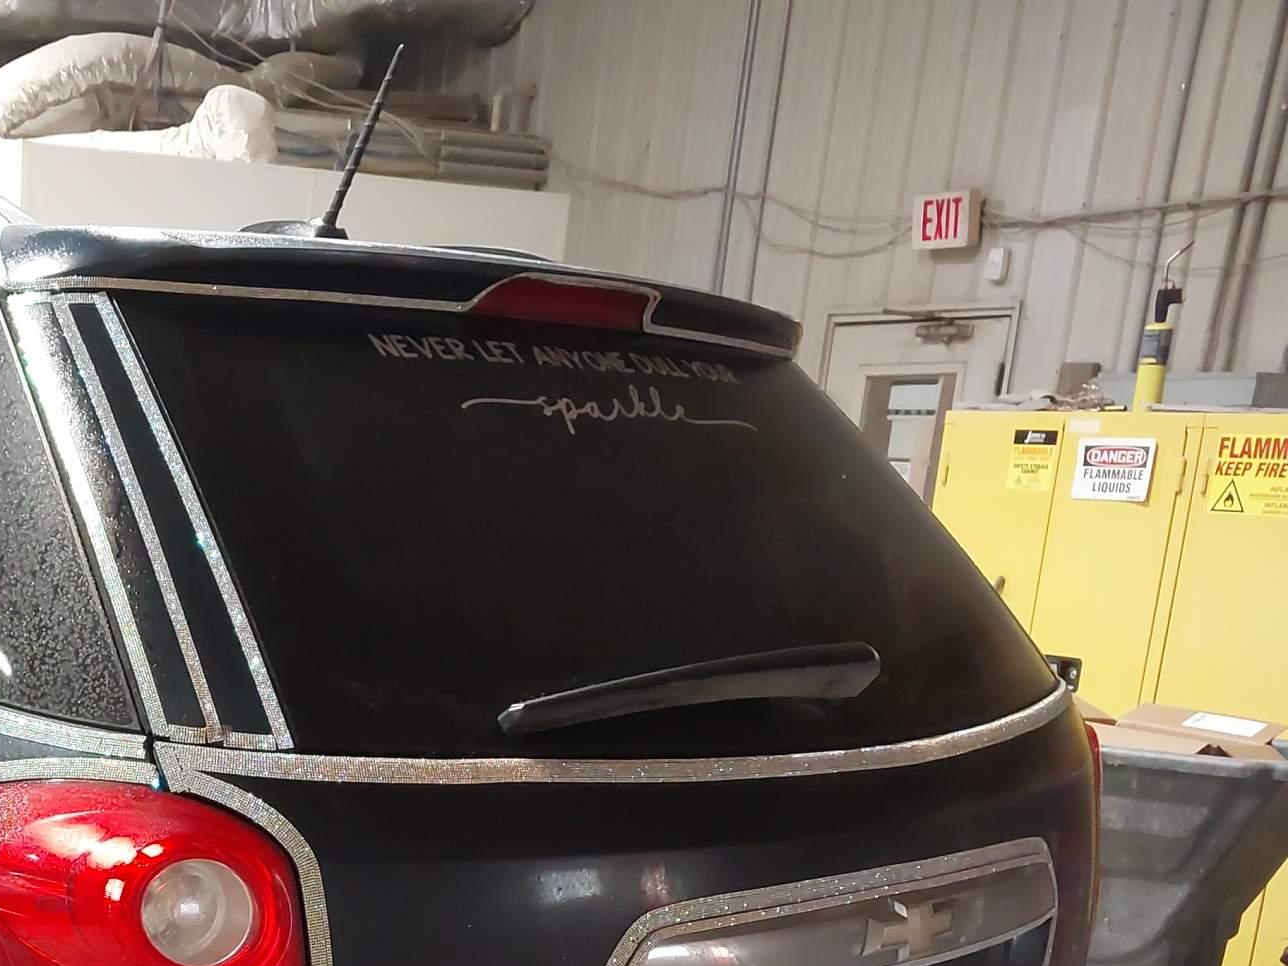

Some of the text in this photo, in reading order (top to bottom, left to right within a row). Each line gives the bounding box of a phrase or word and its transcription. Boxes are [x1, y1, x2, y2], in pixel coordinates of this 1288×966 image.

[922, 197, 962, 241] EXIT
[368, 333, 475, 361] NEVER
[472, 339, 525, 365] LET
[532, 345, 636, 374] ANYONE
[628, 352, 690, 378] DULL
[461, 384, 758, 435] sparkle
[1092, 449, 1144, 464] DANGER
[1083, 468, 1144, 480] FLAMMABLE
[1215, 461, 1288, 478] KEEP FIRE
[1092, 481, 1132, 493] LIQUIDS
